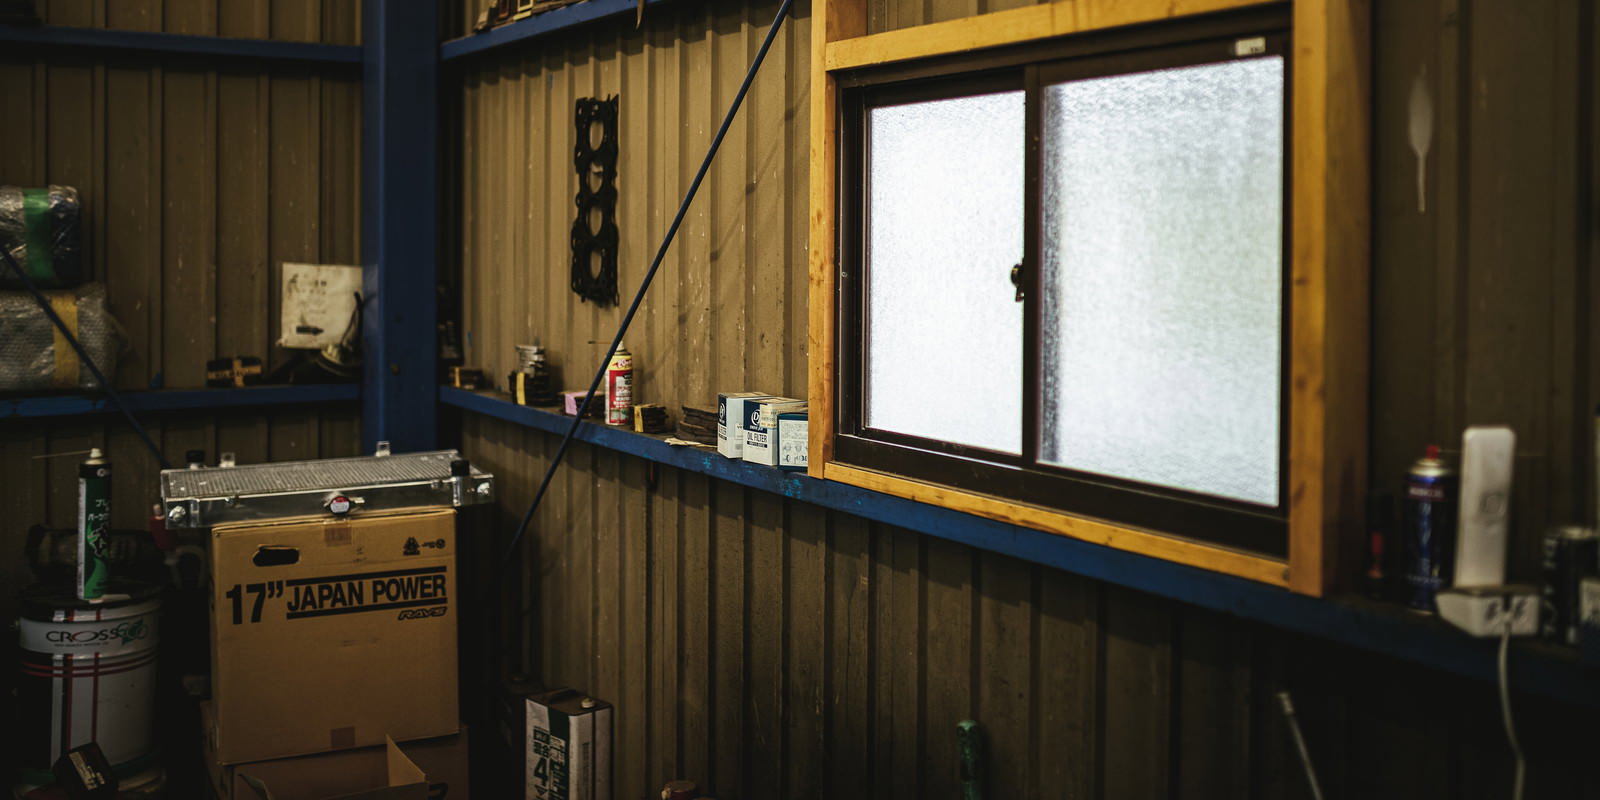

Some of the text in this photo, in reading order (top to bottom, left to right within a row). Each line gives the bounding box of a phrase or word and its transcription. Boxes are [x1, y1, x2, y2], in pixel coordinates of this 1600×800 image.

[754, 433, 767, 443] FILTER
[287, 582, 363, 611] JAPAN
[372, 574, 446, 603] POWER
[398, 607, 448, 620] RAYS
[534, 757, 548, 787] 4
